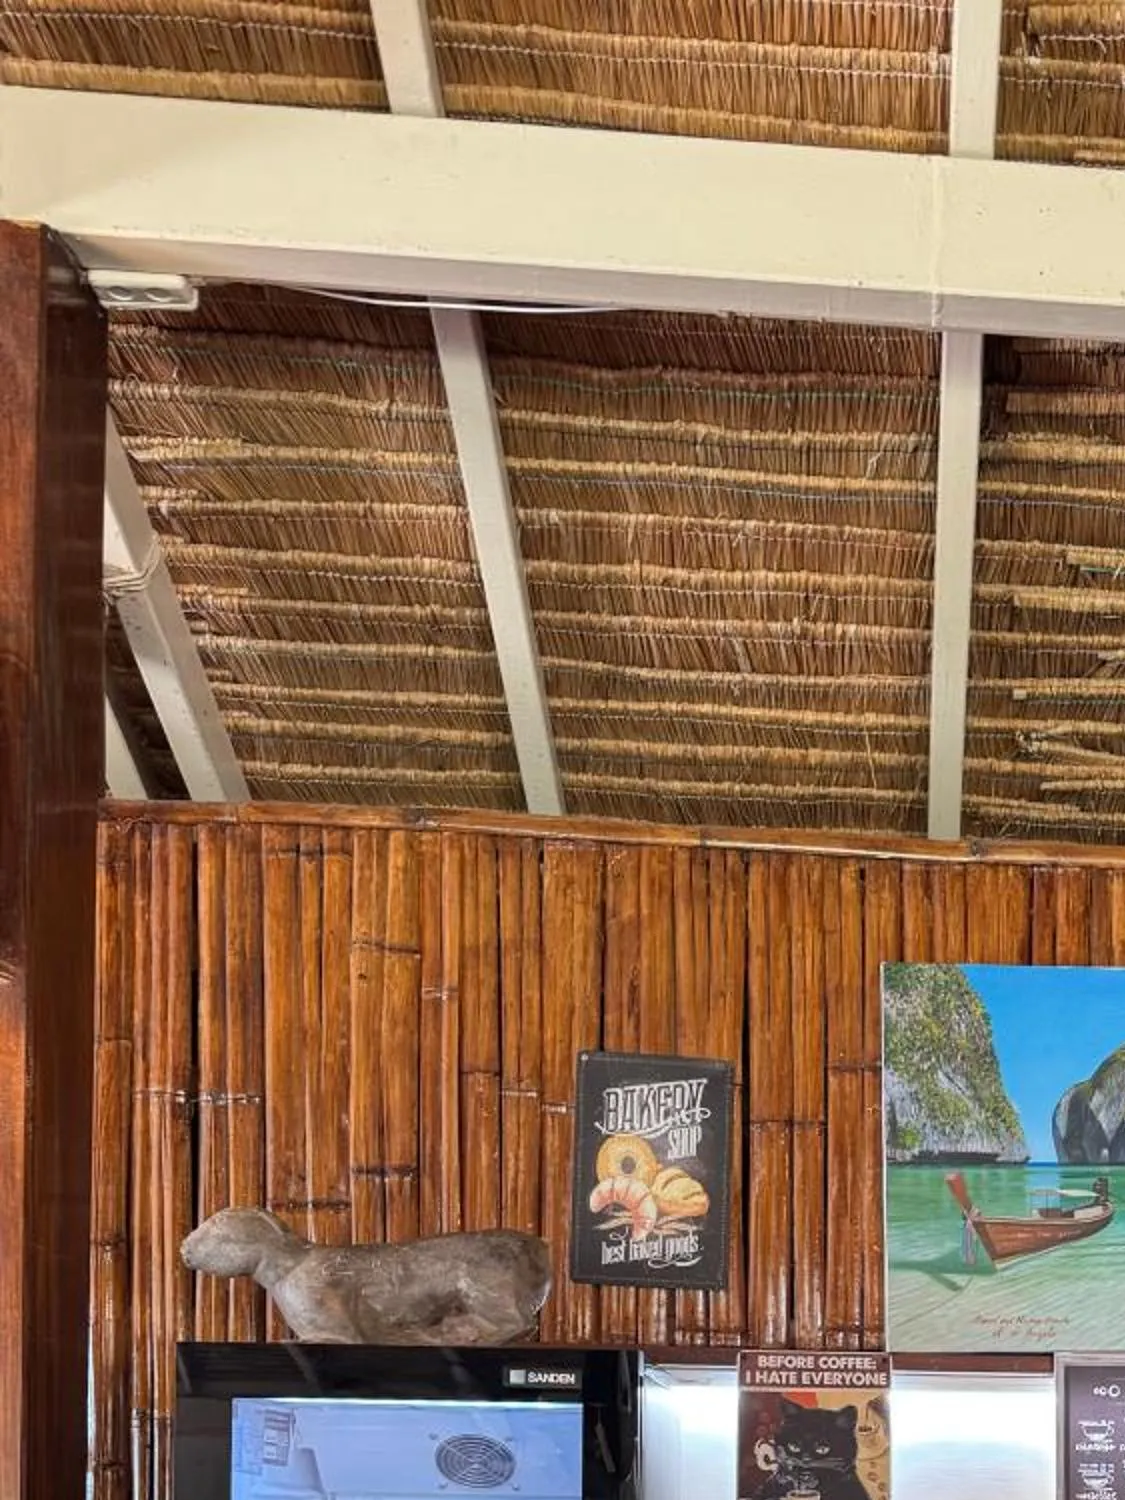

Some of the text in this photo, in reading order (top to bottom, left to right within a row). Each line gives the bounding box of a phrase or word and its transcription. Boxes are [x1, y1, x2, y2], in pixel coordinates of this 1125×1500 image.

[604, 1078, 708, 1131] BAKERY
[757, 1355, 815, 1369] BEFORE
[745, 1371, 888, 1386] I HATE EVERYONE
